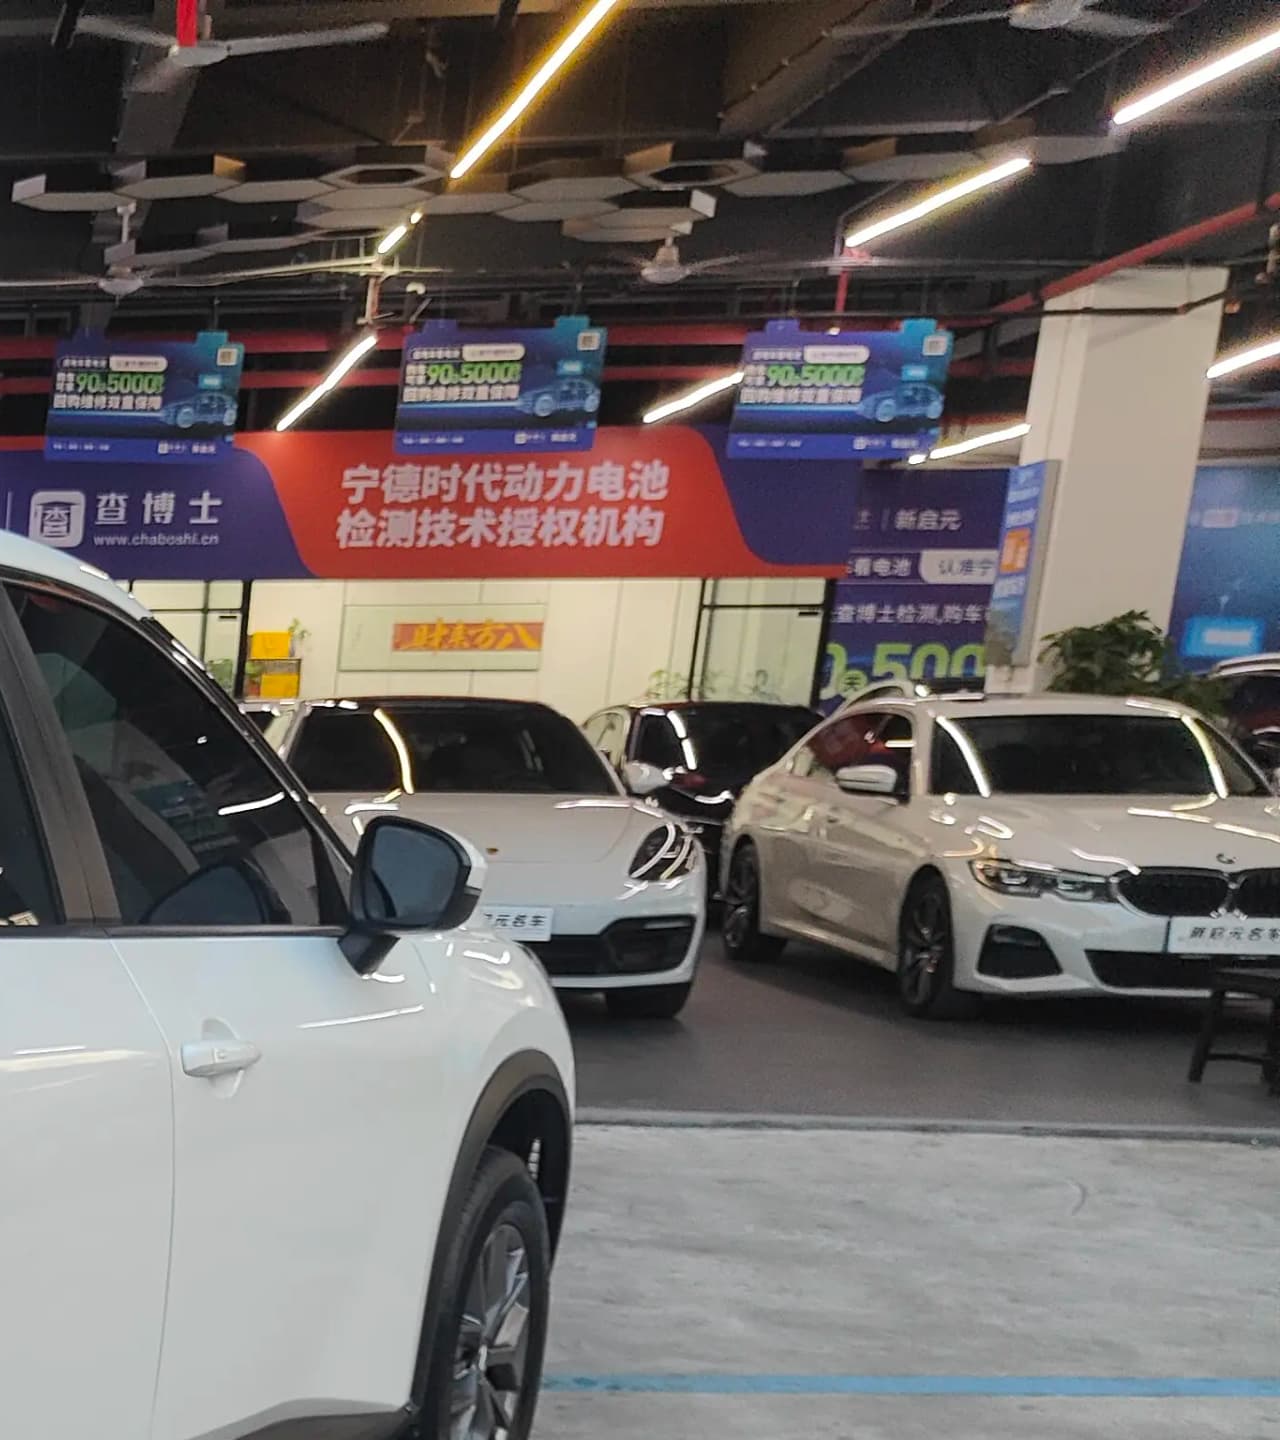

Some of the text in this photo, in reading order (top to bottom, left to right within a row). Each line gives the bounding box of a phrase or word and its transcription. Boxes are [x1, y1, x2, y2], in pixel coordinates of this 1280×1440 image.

[341, 459, 670, 504] 宁德时代动力电池
[95, 490, 223, 526] 查博士
[895, 508, 962, 531] 新启元
[93, 532, 220, 547] www.chaboshi.cn
[336, 505, 666, 549] 检测技术授权机构
